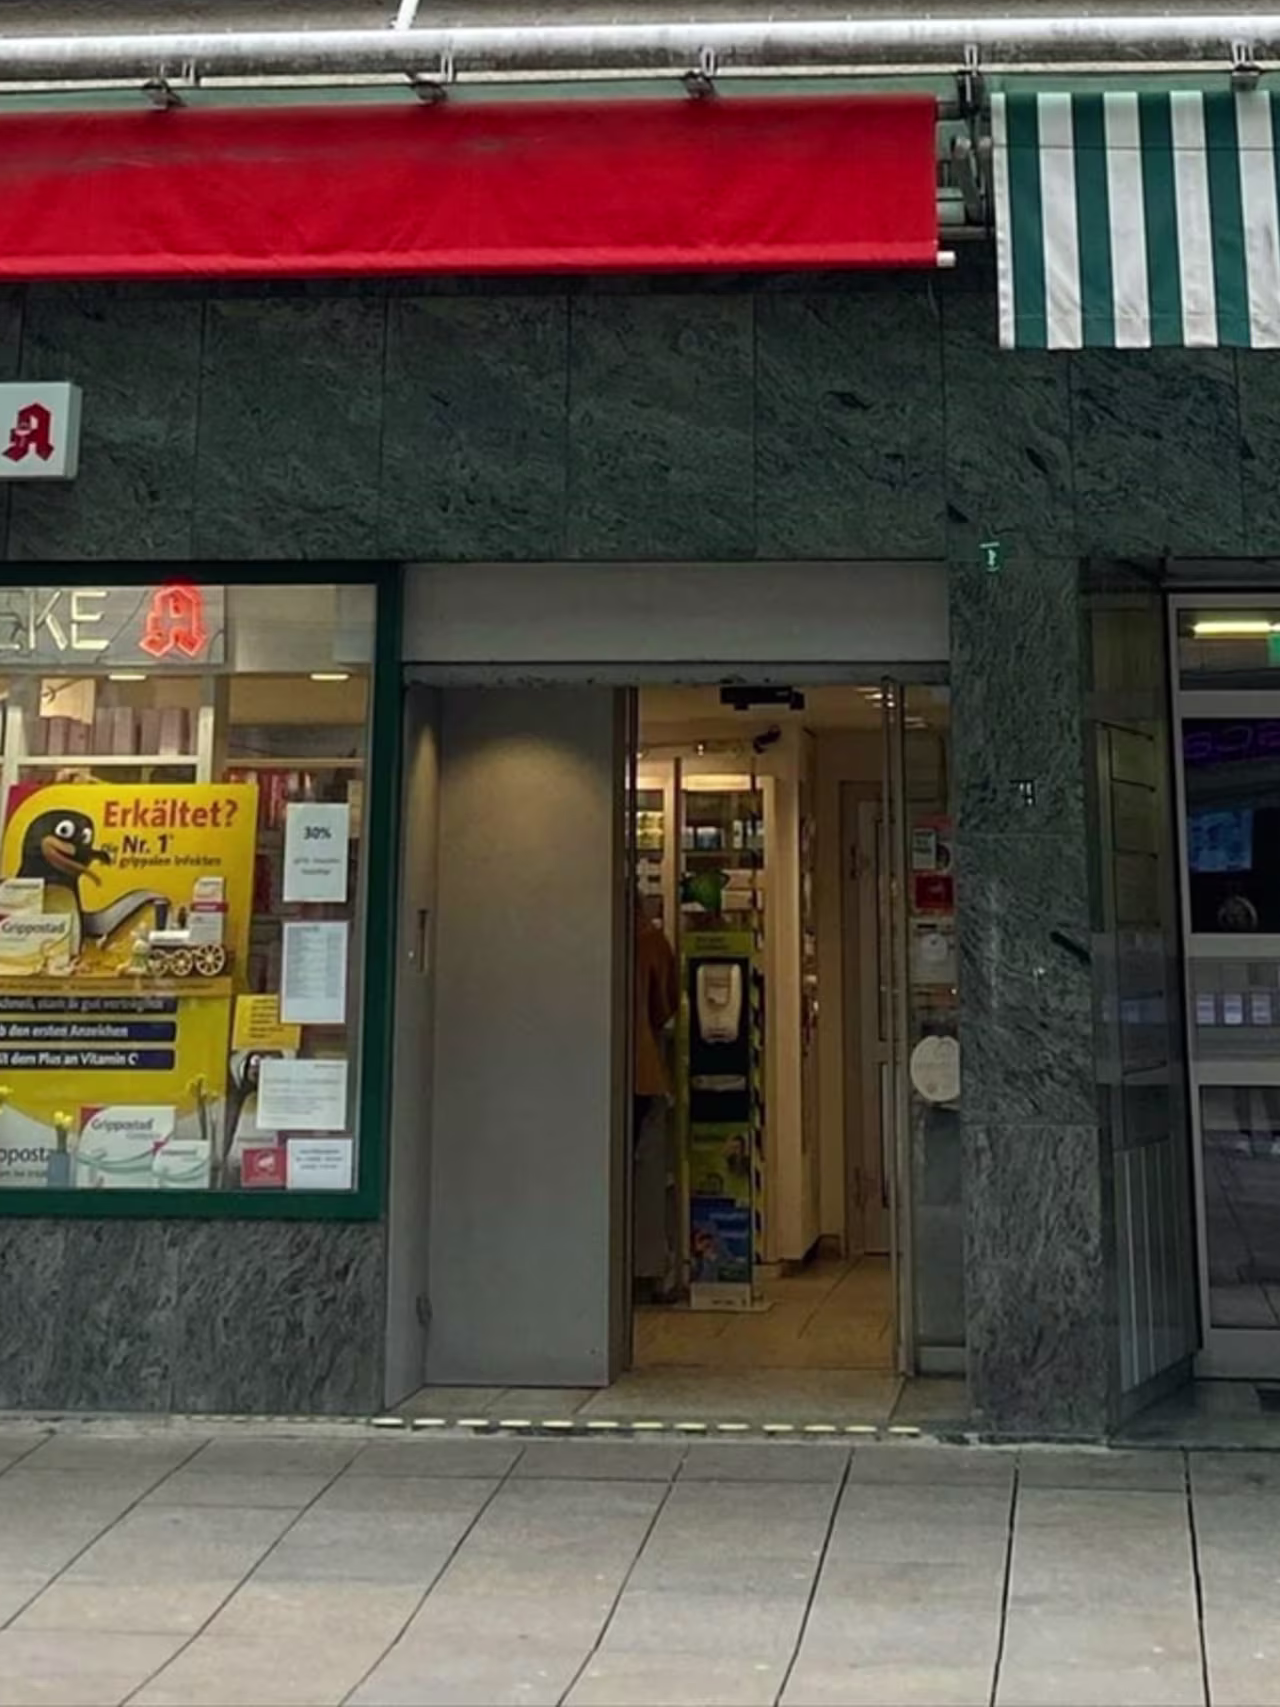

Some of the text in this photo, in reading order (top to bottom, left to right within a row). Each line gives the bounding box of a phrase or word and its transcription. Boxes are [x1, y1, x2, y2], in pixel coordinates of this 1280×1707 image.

[103, 798, 238, 828] Erkältet?
[303, 825, 333, 840] 30%
[122, 835, 151, 854] Nr.
